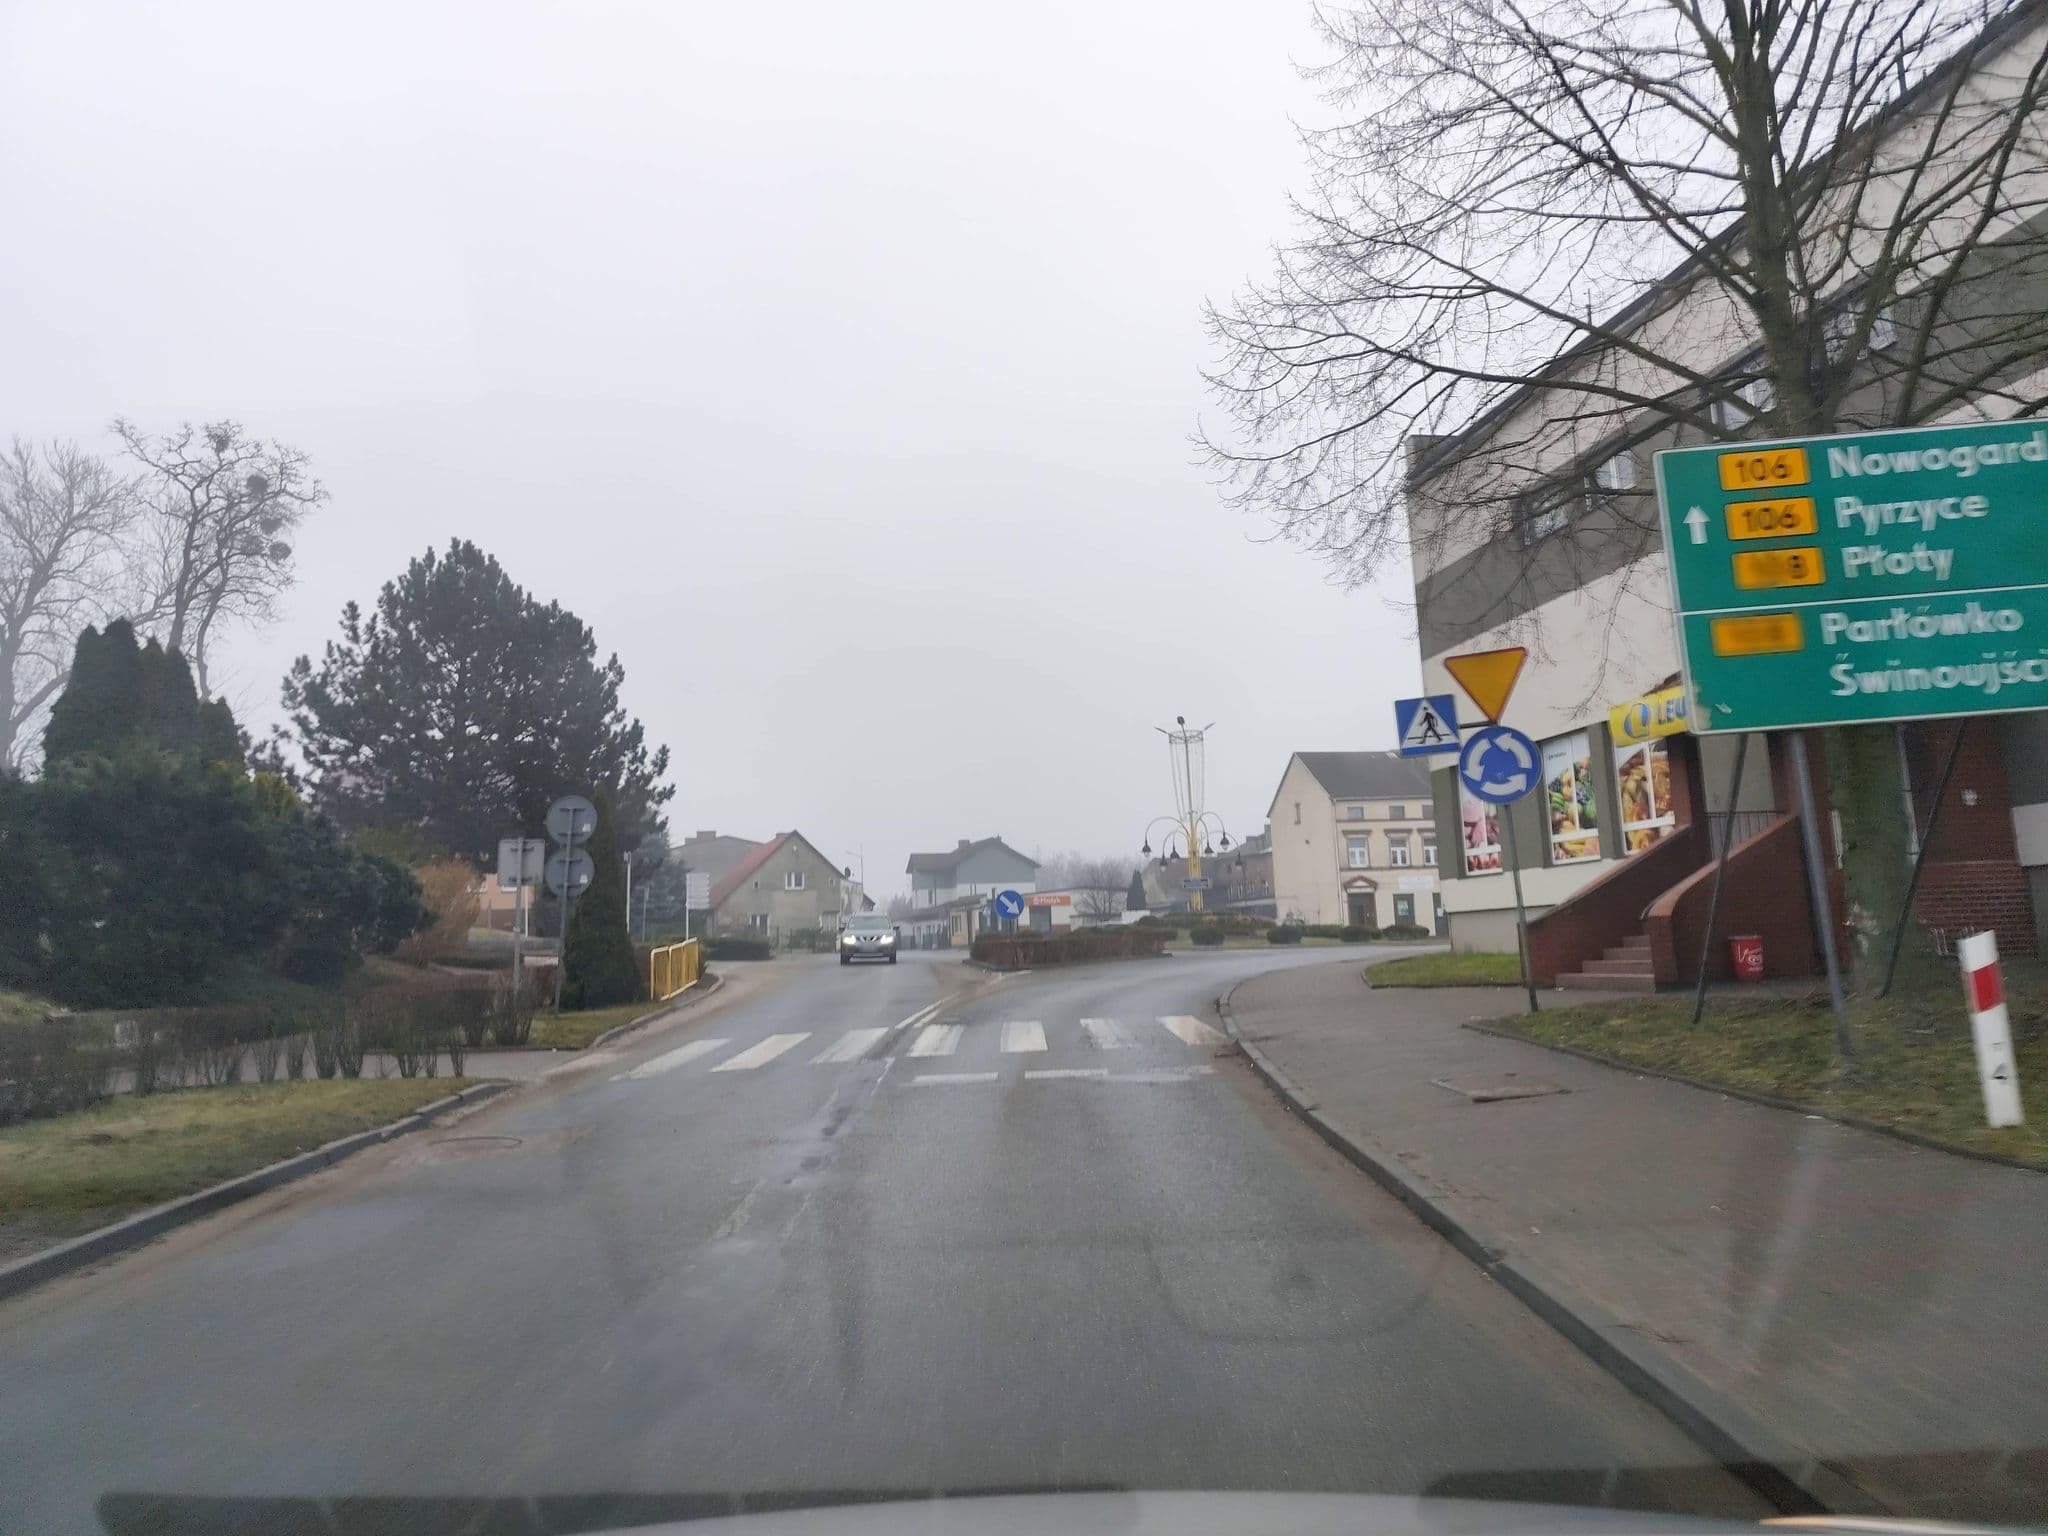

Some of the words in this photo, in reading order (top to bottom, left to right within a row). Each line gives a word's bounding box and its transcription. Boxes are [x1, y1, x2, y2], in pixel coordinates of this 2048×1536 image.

[1735, 455, 1793, 484] 106
[1827, 430, 2048, 479] Nowogard
[1741, 503, 1801, 533] 106
[1834, 494, 1991, 536] Pyrzyce
[1841, 541, 1954, 581] Płoty
[1819, 601, 2025, 645] Parłówko
